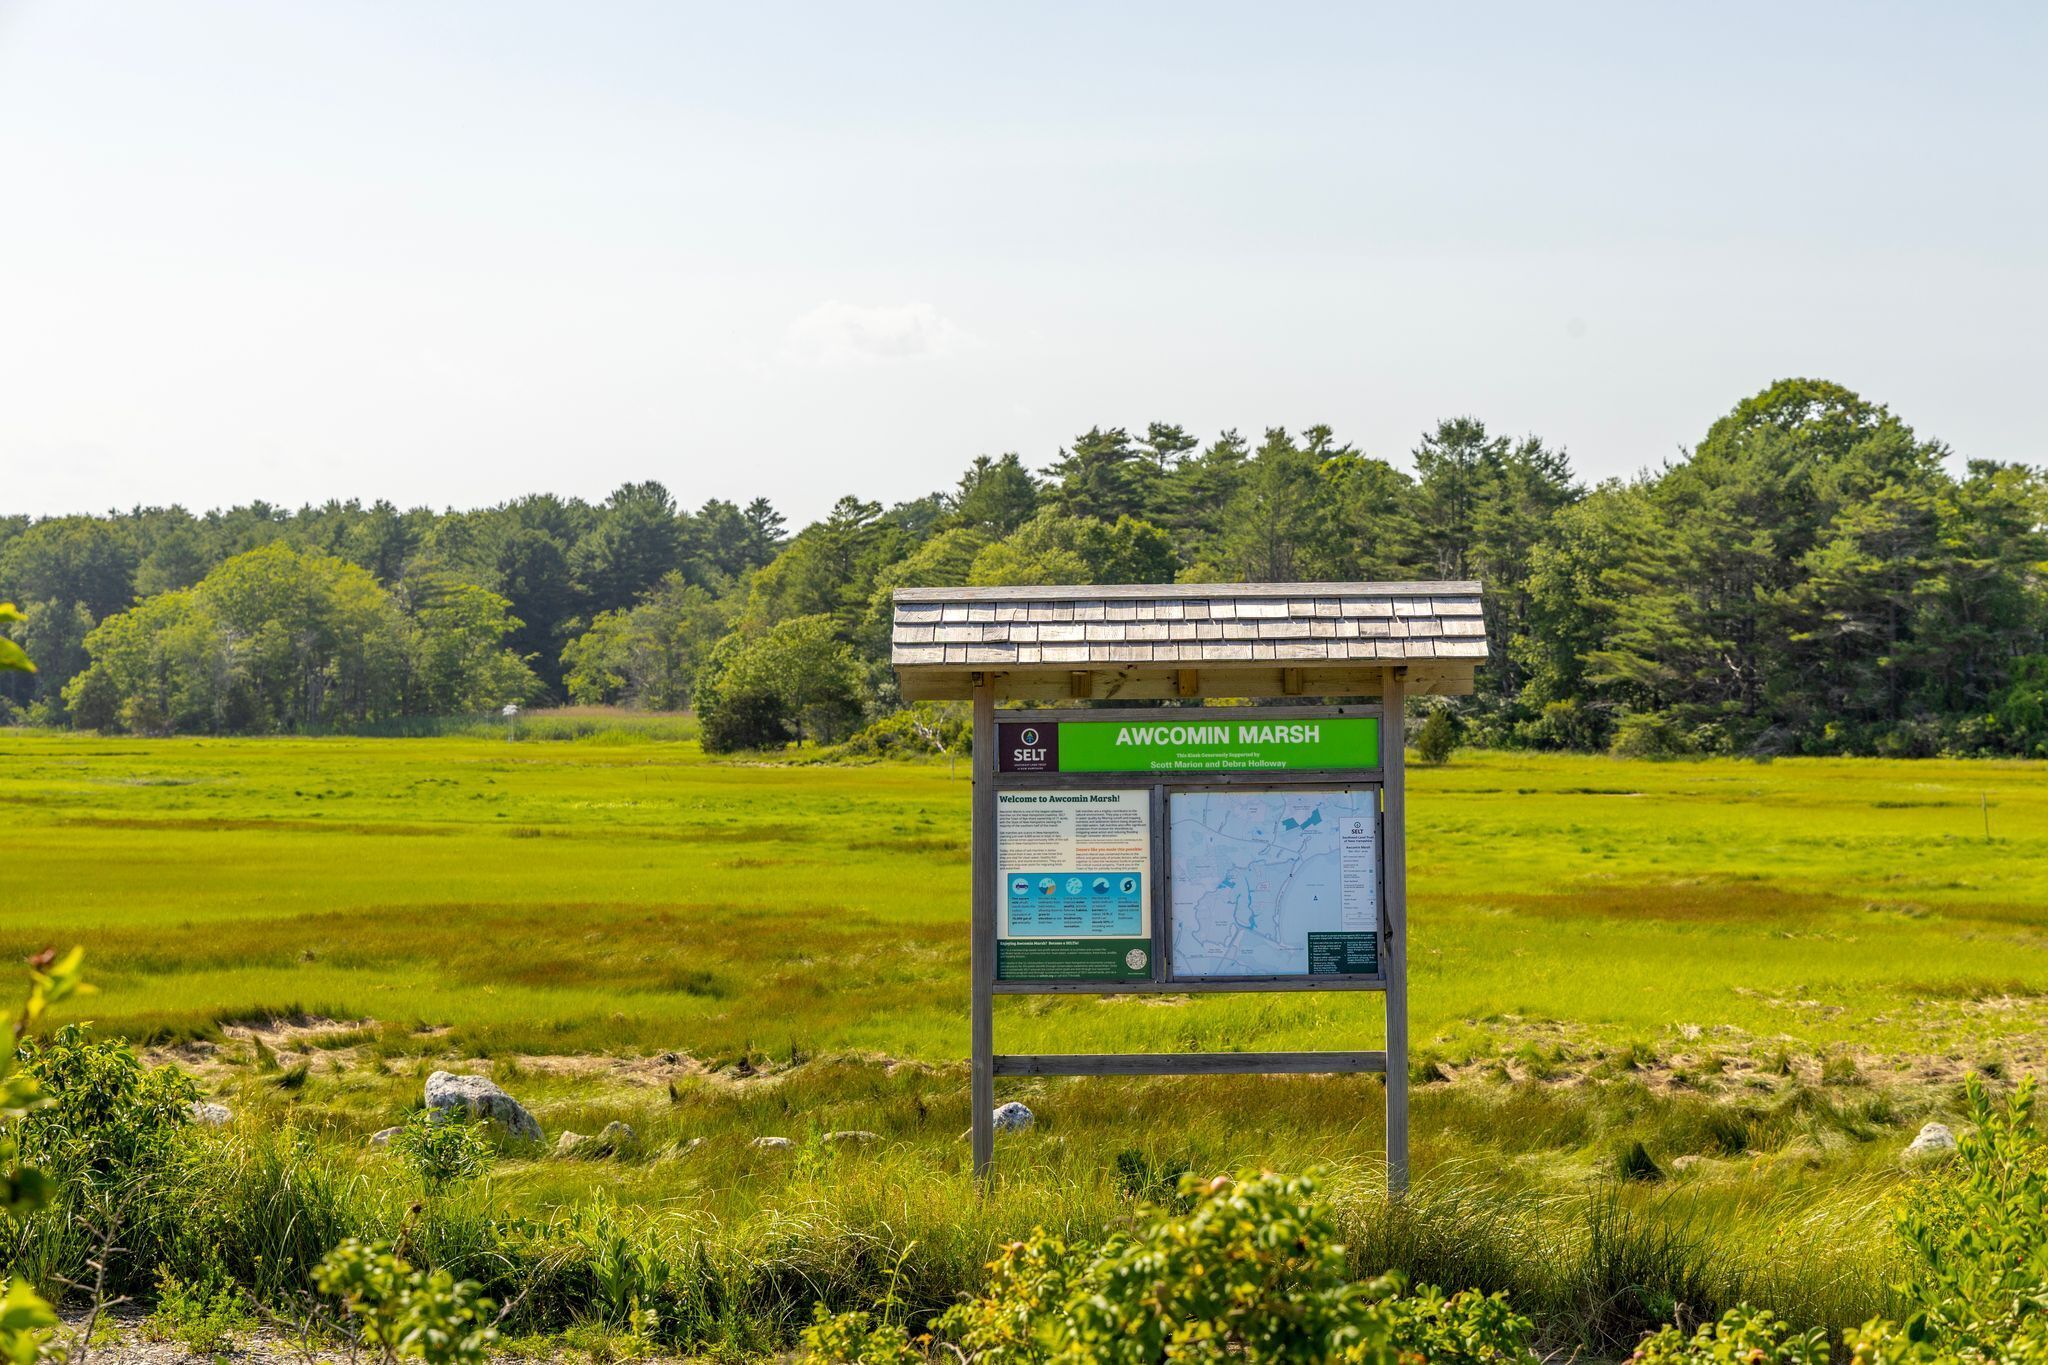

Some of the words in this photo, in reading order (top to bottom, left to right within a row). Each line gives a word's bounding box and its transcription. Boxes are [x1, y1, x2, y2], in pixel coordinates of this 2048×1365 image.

[1116, 726, 1230, 745] AWCOMIN
[1239, 725, 1319, 744] MARSH
[1013, 748, 1047, 761] SELT
[1205, 760, 1220, 768] and
[1222, 760, 1246, 768] Debra
[1248, 760, 1287, 768] Holloway
[999, 795, 1037, 803] Welcome
[1049, 795, 1088, 803] Awcomin
